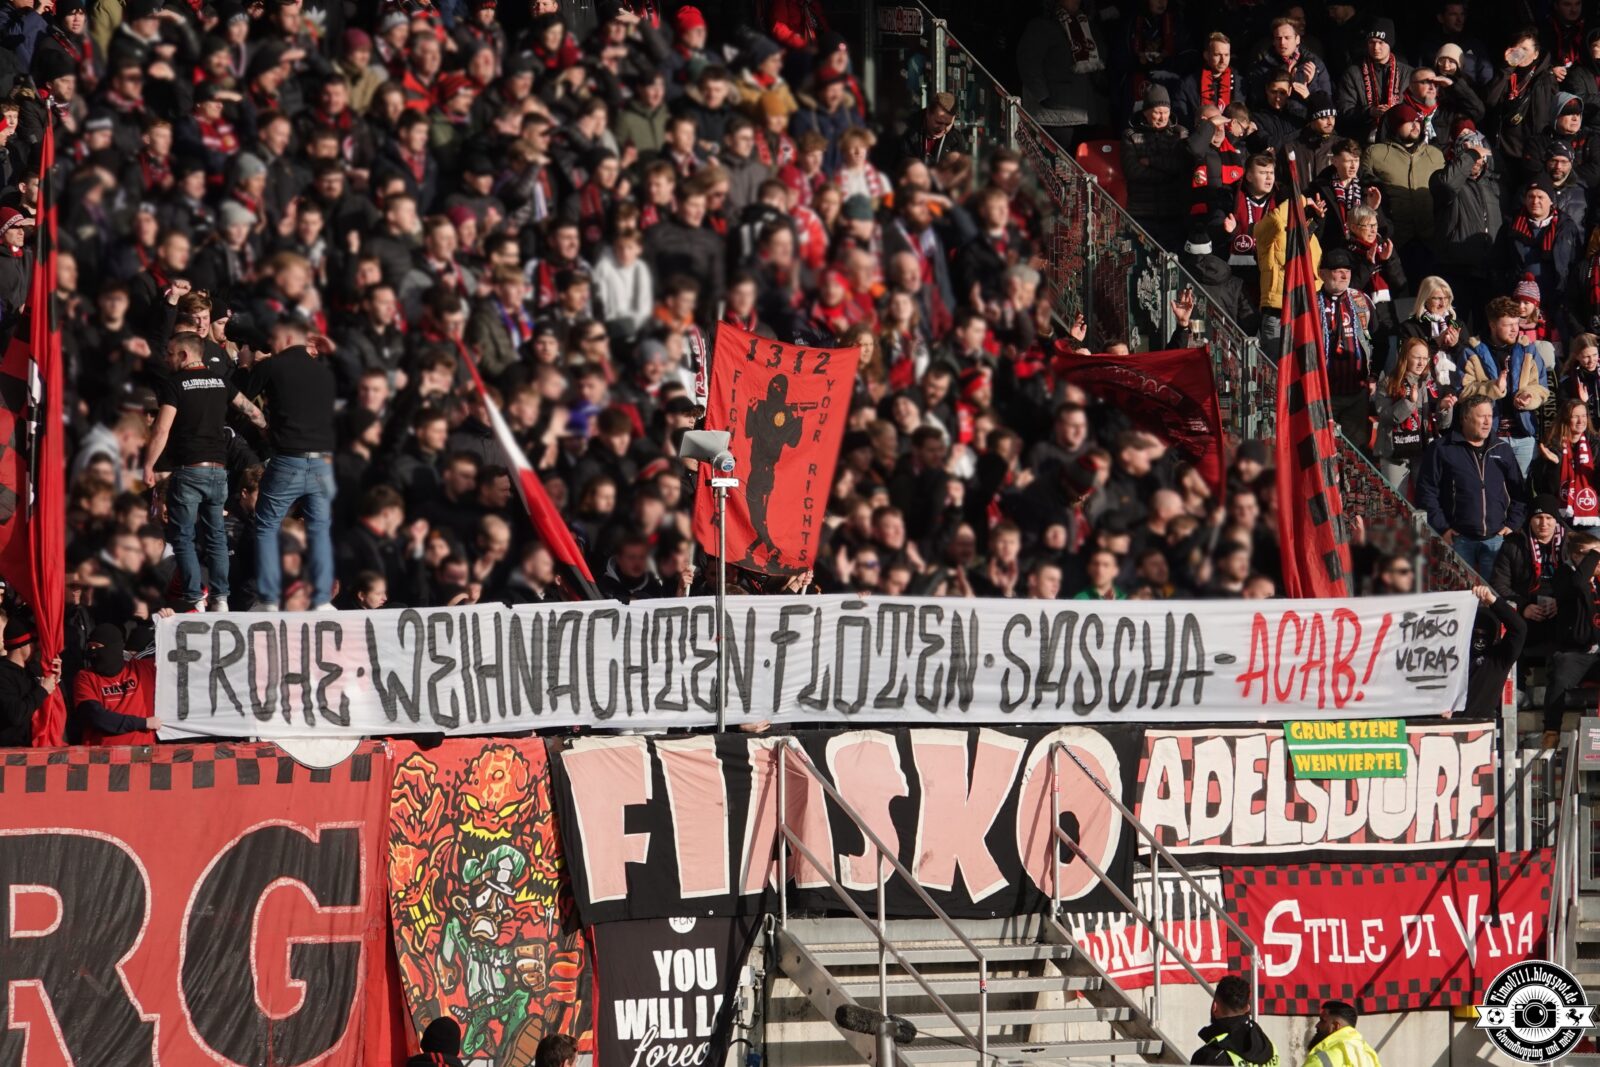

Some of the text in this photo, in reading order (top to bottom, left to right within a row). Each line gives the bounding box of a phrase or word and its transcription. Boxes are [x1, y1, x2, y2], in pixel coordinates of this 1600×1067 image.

[746, 338, 831, 375] 1312
[797, 379, 836, 562] YOUR RIGHTS
[1579, 497, 1595, 506] FCN
[1399, 612, 1459, 642] FIASKO
[168, 620, 351, 727] FROHE
[365, 604, 755, 730] WEIHNACHTEN
[999, 609, 1214, 716] SASCHA
[1236, 607, 1393, 711] ACAB!
[1396, 646, 1459, 673] ULTRAS
[1290, 720, 1397, 739] GRÜNE SZENE
[1295, 752, 1402, 772] WEINVIERTEL
[1139, 732, 1493, 846] ADELSDORF
[563, 726, 1123, 903] FIASKO
[1263, 894, 1534, 977] STILE DI VITA
[652, 948, 718, 992] YOU
[614, 997, 688, 1040] WILL
